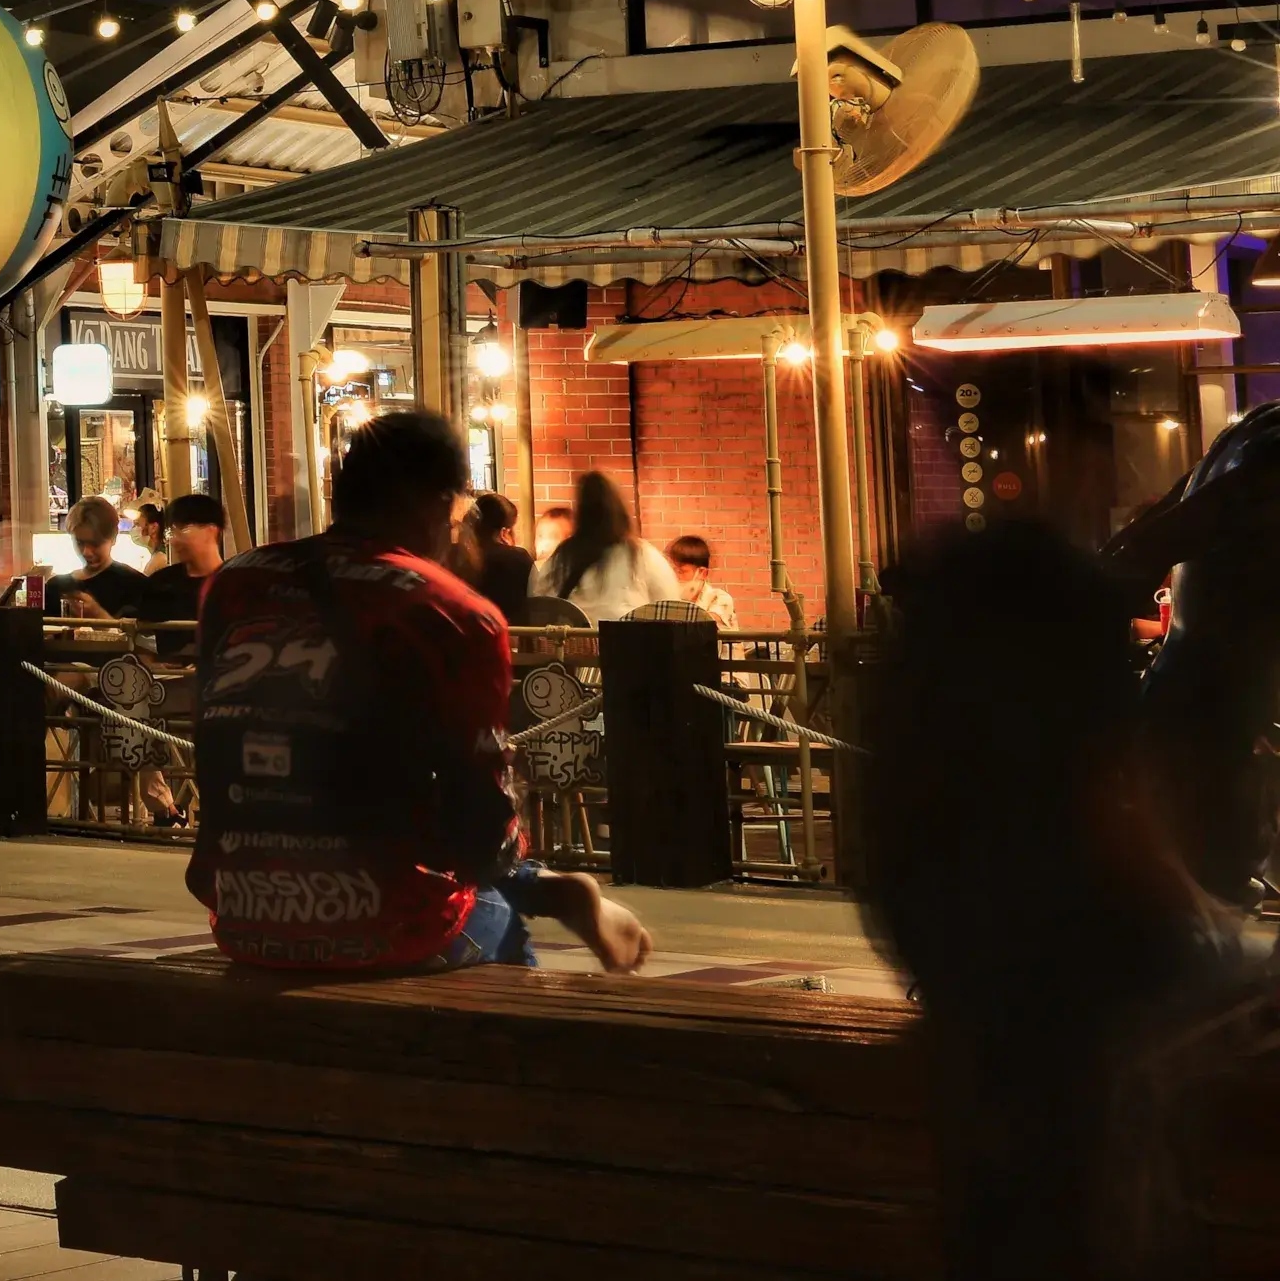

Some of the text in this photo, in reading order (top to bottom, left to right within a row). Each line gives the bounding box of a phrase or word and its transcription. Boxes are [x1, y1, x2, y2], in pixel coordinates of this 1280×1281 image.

[99, 321, 149, 370] DANG
[102, 735, 167, 768] Fish
[525, 731, 600, 757] Happy
[526, 751, 602, 787] Fish
[214, 869, 381, 899] MISSION
[216, 895, 382, 923] WINNOW
